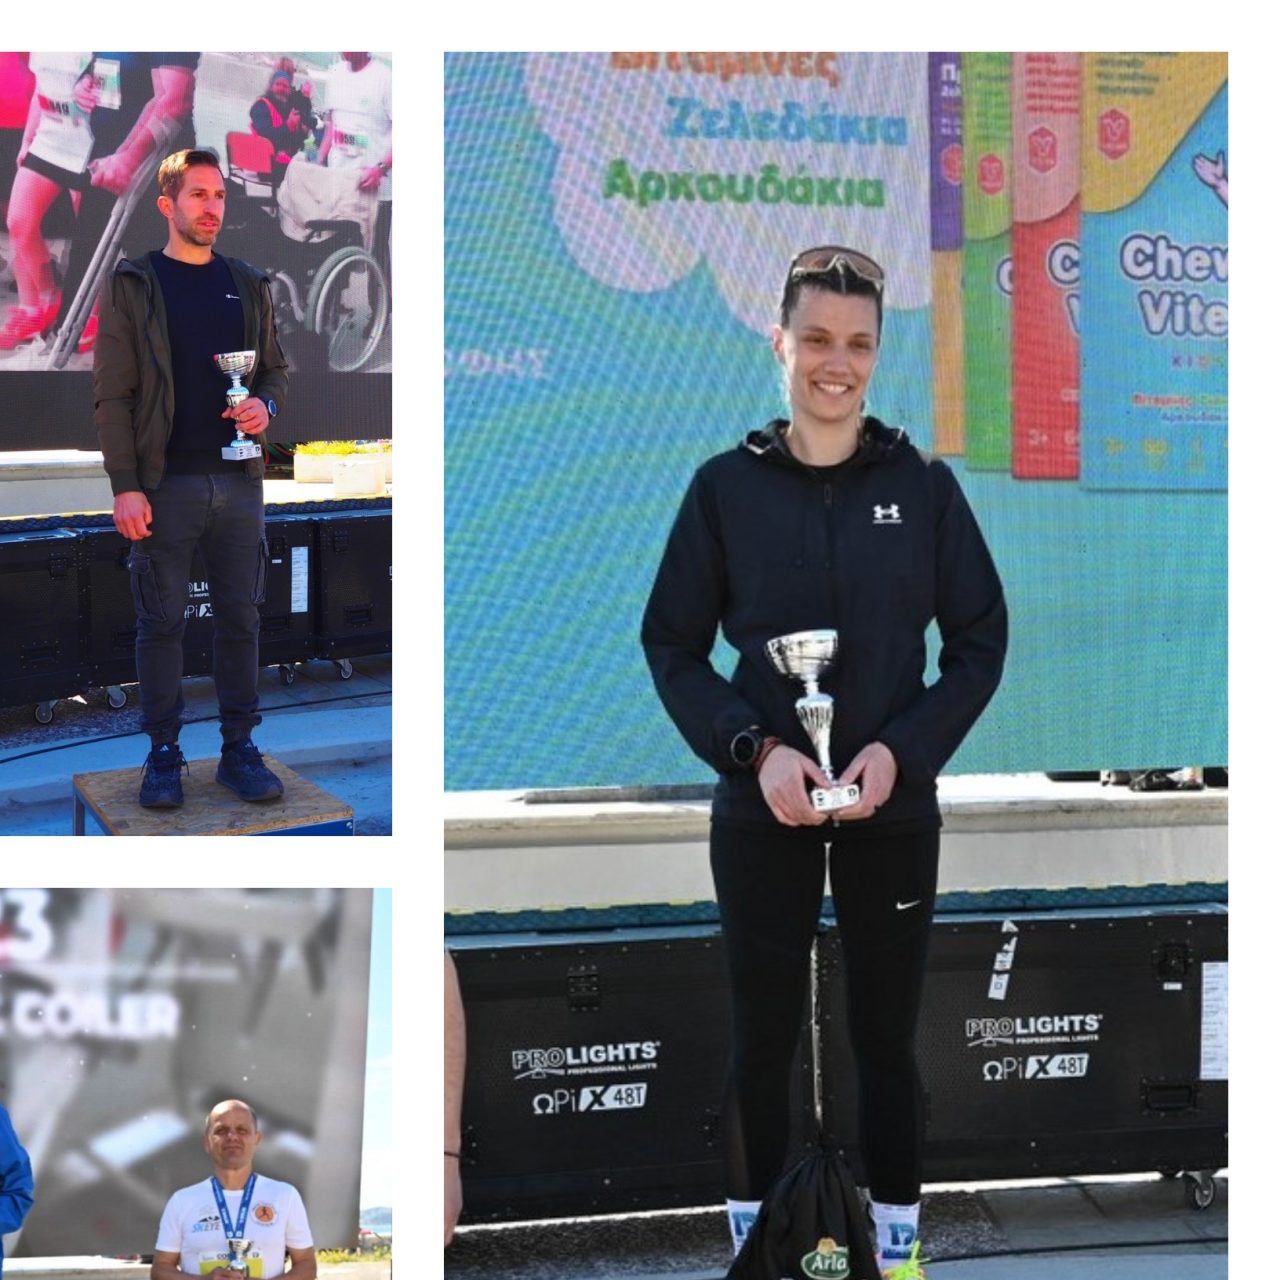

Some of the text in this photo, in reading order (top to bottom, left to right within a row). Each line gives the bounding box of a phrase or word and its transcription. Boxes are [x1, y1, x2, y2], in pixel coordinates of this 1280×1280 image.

[602, 157, 885, 208] Αρκουδάκια
[966, 1013, 1099, 1037] PROLIGHTS
[512, 1042, 657, 1069] PROLIGHTS
[1058, 1056, 1085, 1074] 48T
[614, 1086, 643, 1105] 48T
[811, 1254, 848, 1271] Arla
